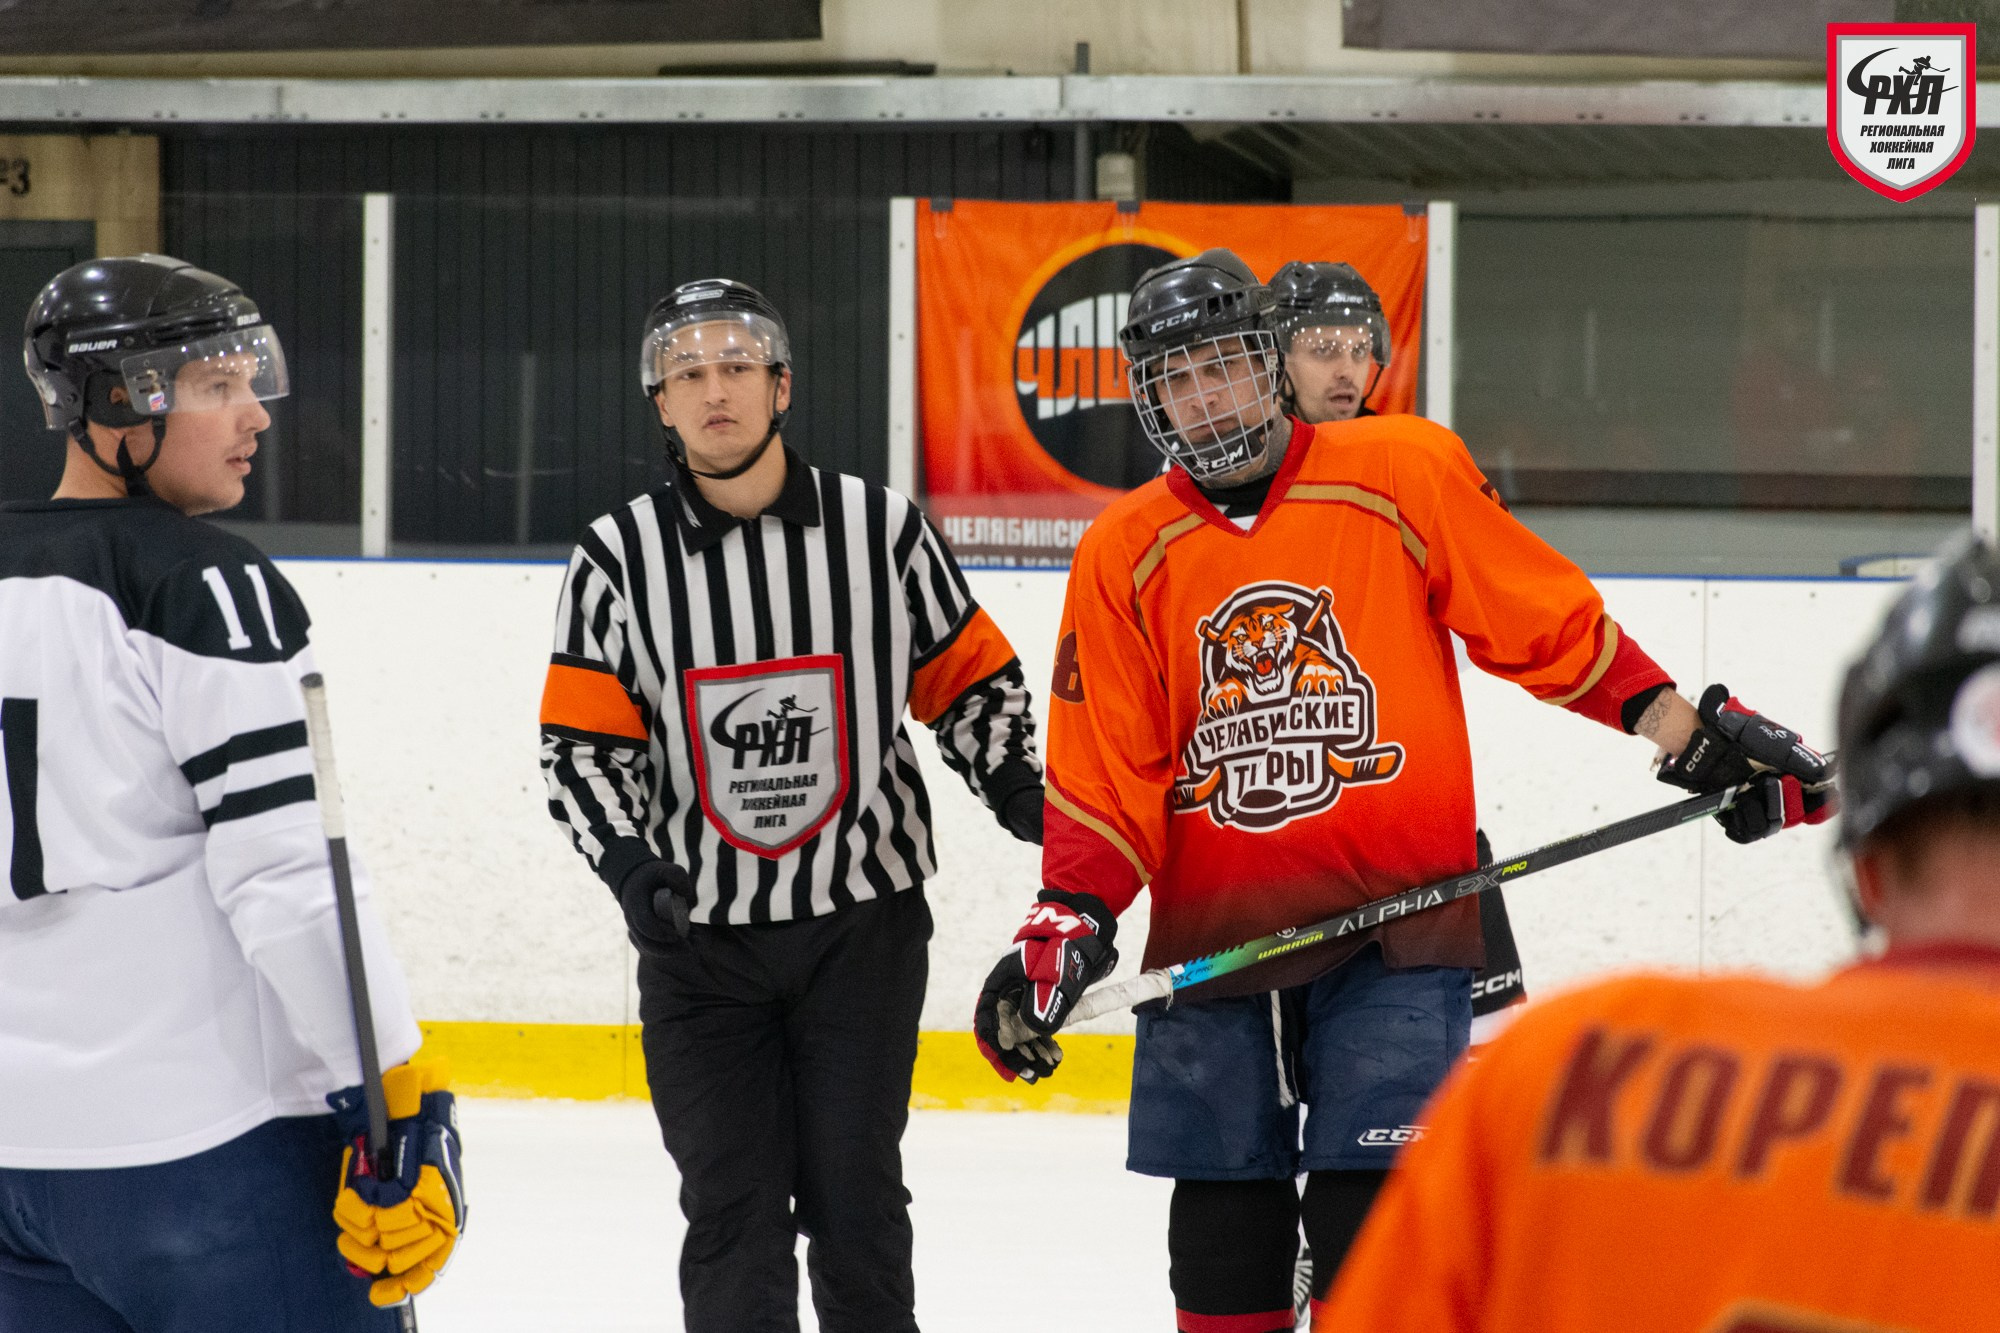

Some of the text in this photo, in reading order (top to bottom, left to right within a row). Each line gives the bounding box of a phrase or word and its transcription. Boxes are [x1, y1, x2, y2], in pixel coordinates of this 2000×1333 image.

[1151, 308, 1199, 334] CCM
[68, 338, 118, 354] BAUER
[1196, 444, 1244, 470] CCM
[202, 564, 283, 651] 11
[732, 716, 813, 770] РХЛ
[1685, 736, 1710, 773] CCM
[1791, 745, 1818, 768] CCM
[753, 814, 787, 829] ЛИГА
[1257, 932, 1324, 961] WARRIOR
[1336, 889, 1444, 937] ALPHA
[1455, 868, 1502, 898] DX
[1502, 860, 1527, 876] PRO
[1048, 991, 1064, 1024] CCM
